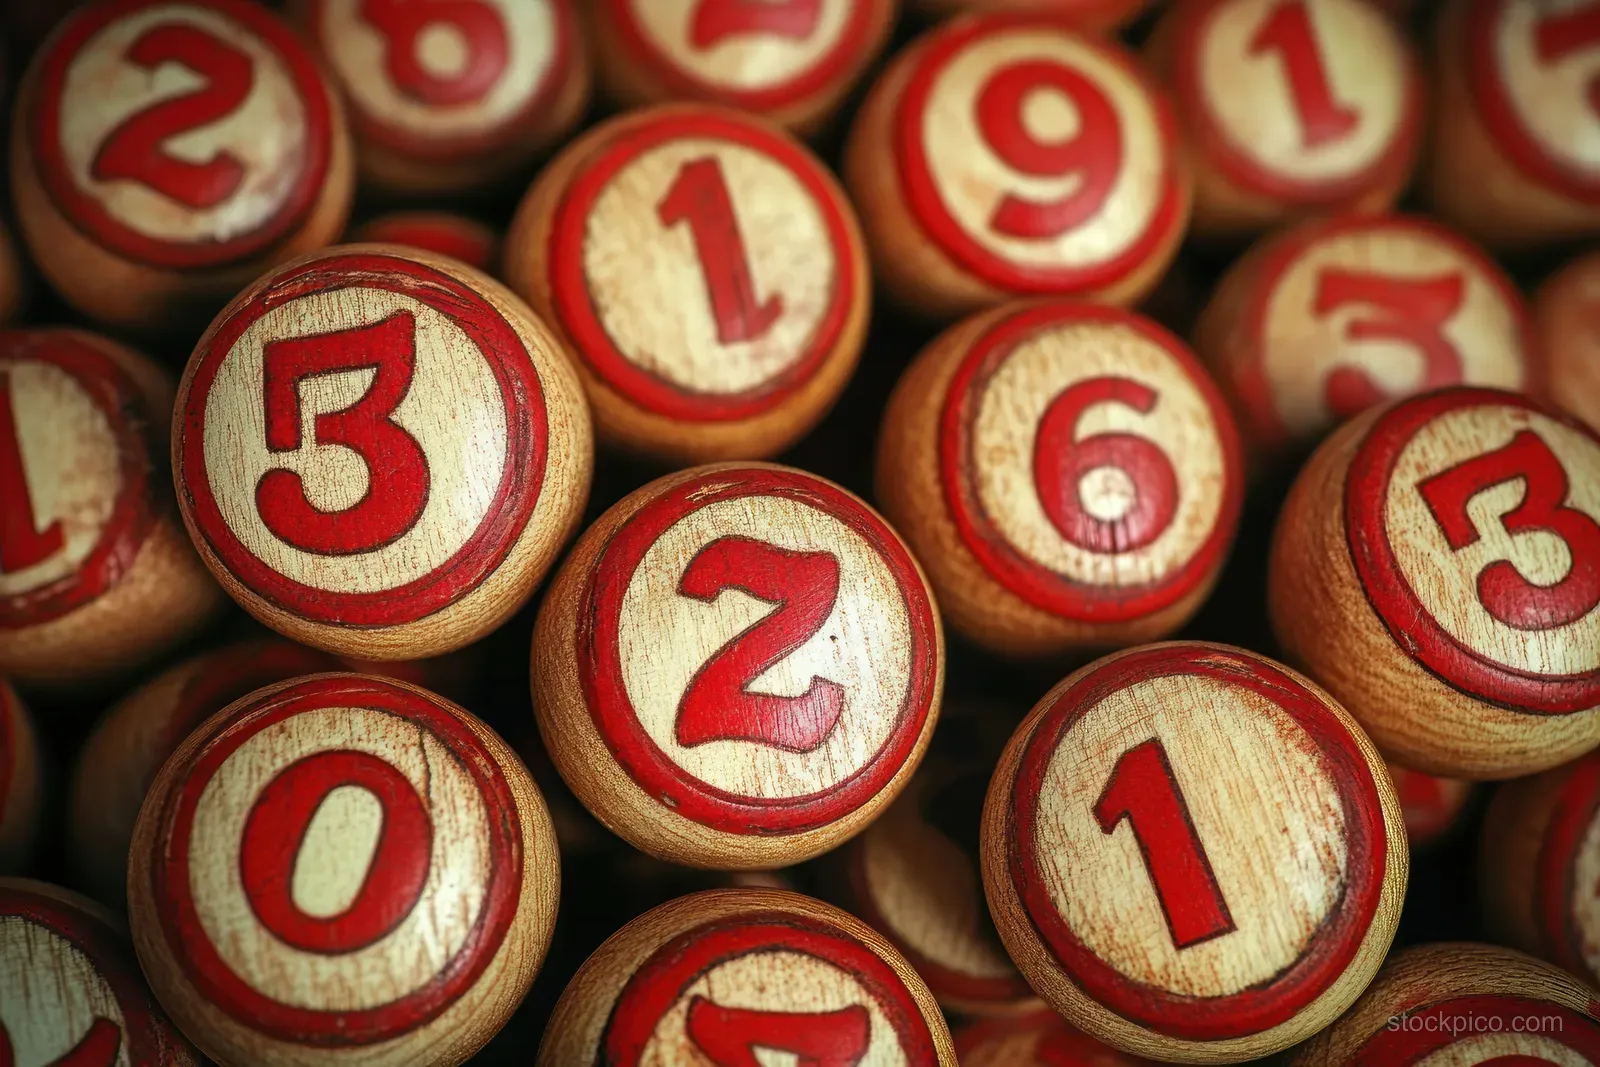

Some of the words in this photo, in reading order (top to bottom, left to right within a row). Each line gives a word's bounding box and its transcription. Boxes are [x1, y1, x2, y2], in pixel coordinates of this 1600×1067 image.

[92, 23, 254, 210] 2
[974, 57, 1124, 242] 9
[1248, 0, 1358, 147] 1
[657, 156, 783, 345] 1
[1031, 376, 1179, 554] 6
[675, 536, 844, 755] 2
[239, 748, 434, 956] 0
[1092, 738, 1238, 951] 1
